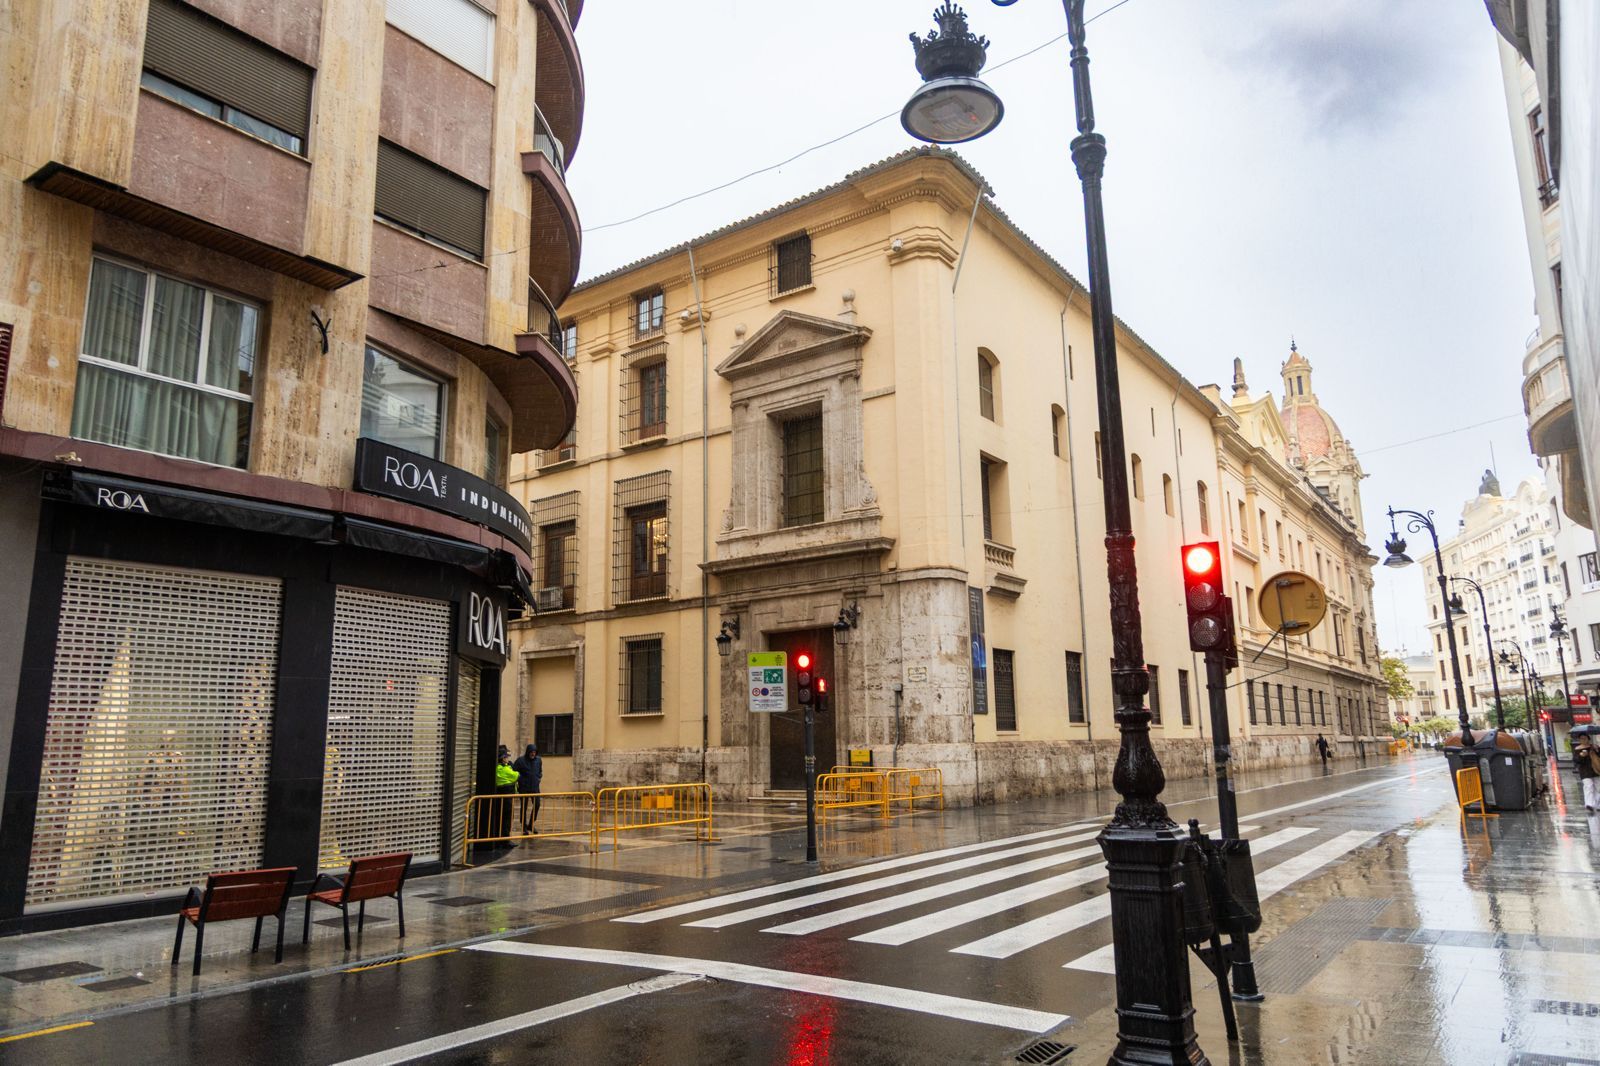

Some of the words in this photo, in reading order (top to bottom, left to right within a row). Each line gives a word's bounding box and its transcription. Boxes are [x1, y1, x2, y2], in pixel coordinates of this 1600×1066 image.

[384, 455, 440, 498] ROA
[440, 474, 448, 499] TEXTIL
[97, 487, 150, 513] ROA
[468, 591, 506, 655] ROA
